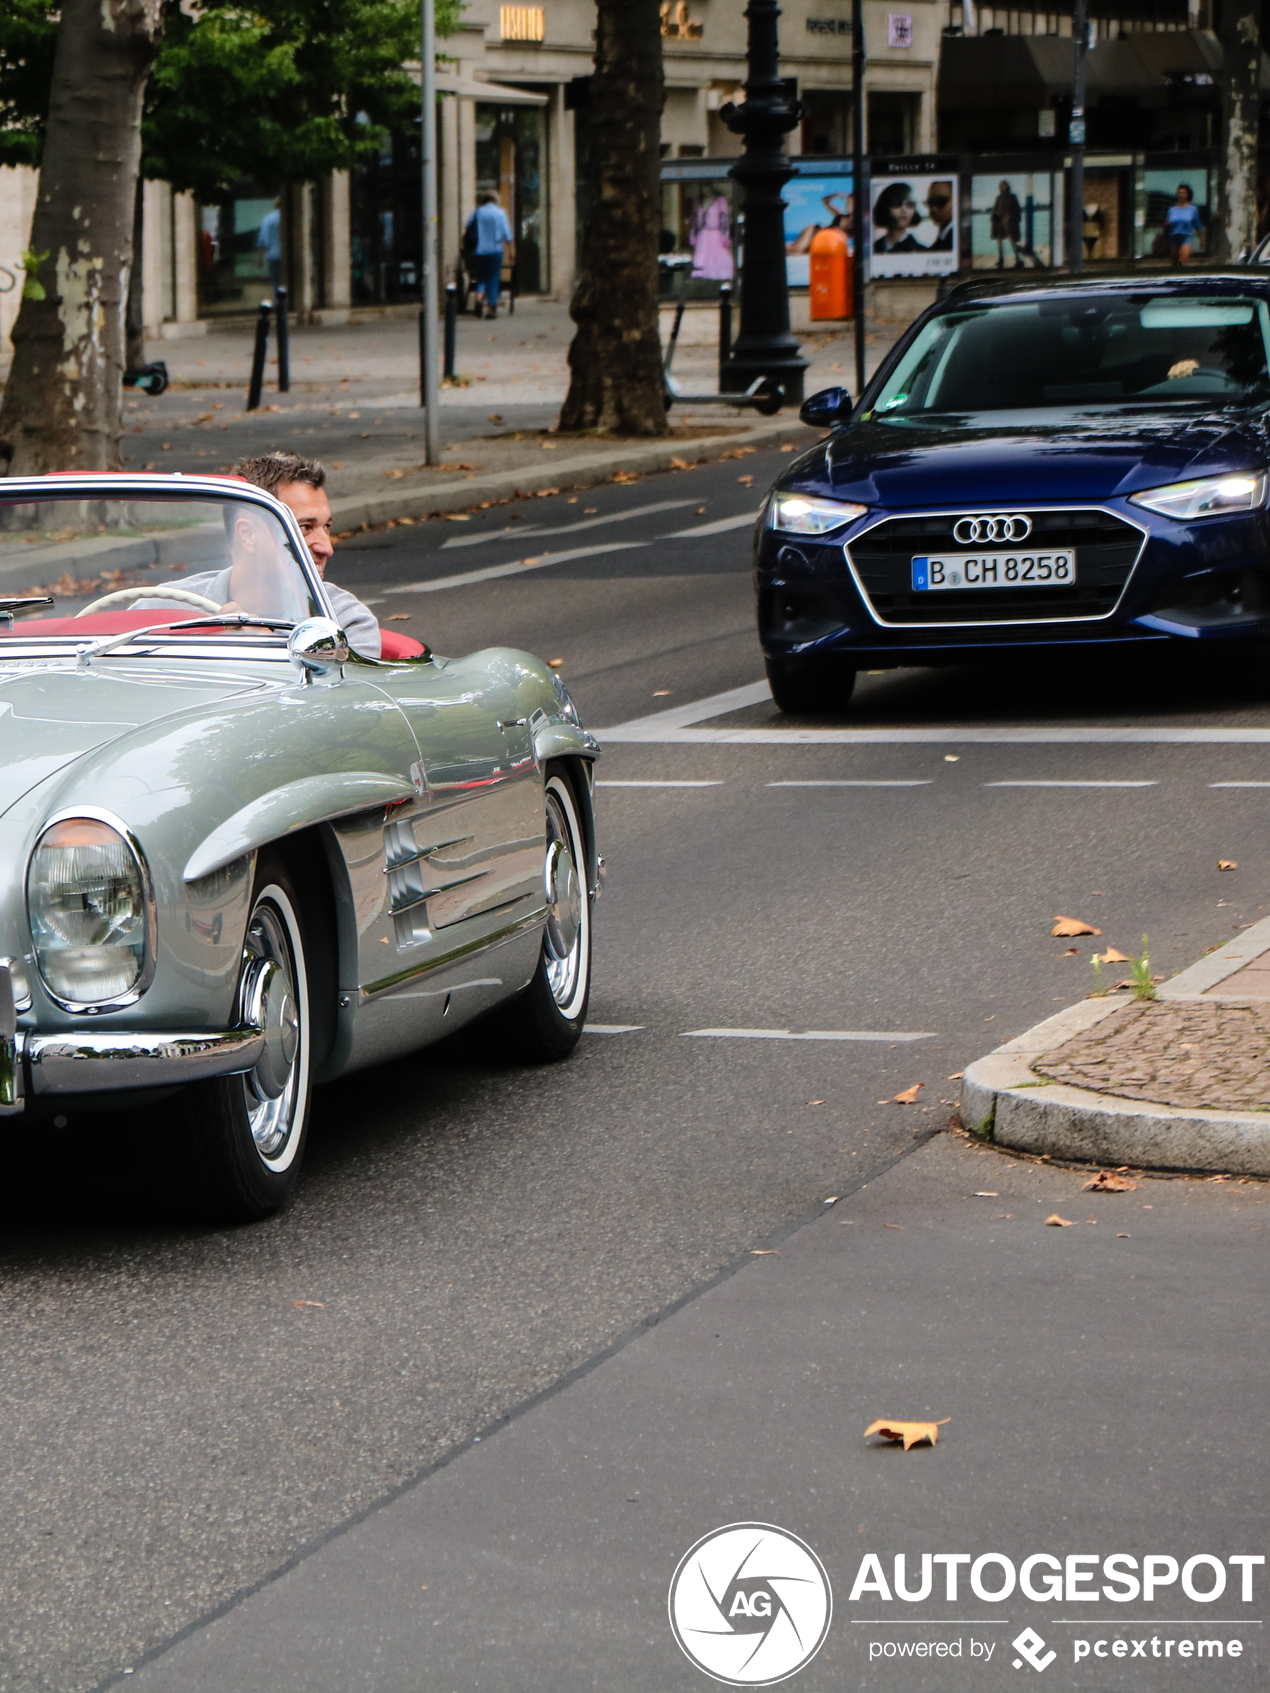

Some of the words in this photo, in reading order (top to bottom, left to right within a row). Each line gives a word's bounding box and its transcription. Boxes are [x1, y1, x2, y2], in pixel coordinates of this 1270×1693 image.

[917, 577, 924, 585] D
[930, 560, 946, 585] B
[964, 558, 998, 583] CH
[1004, 555, 1069, 582] 8258
